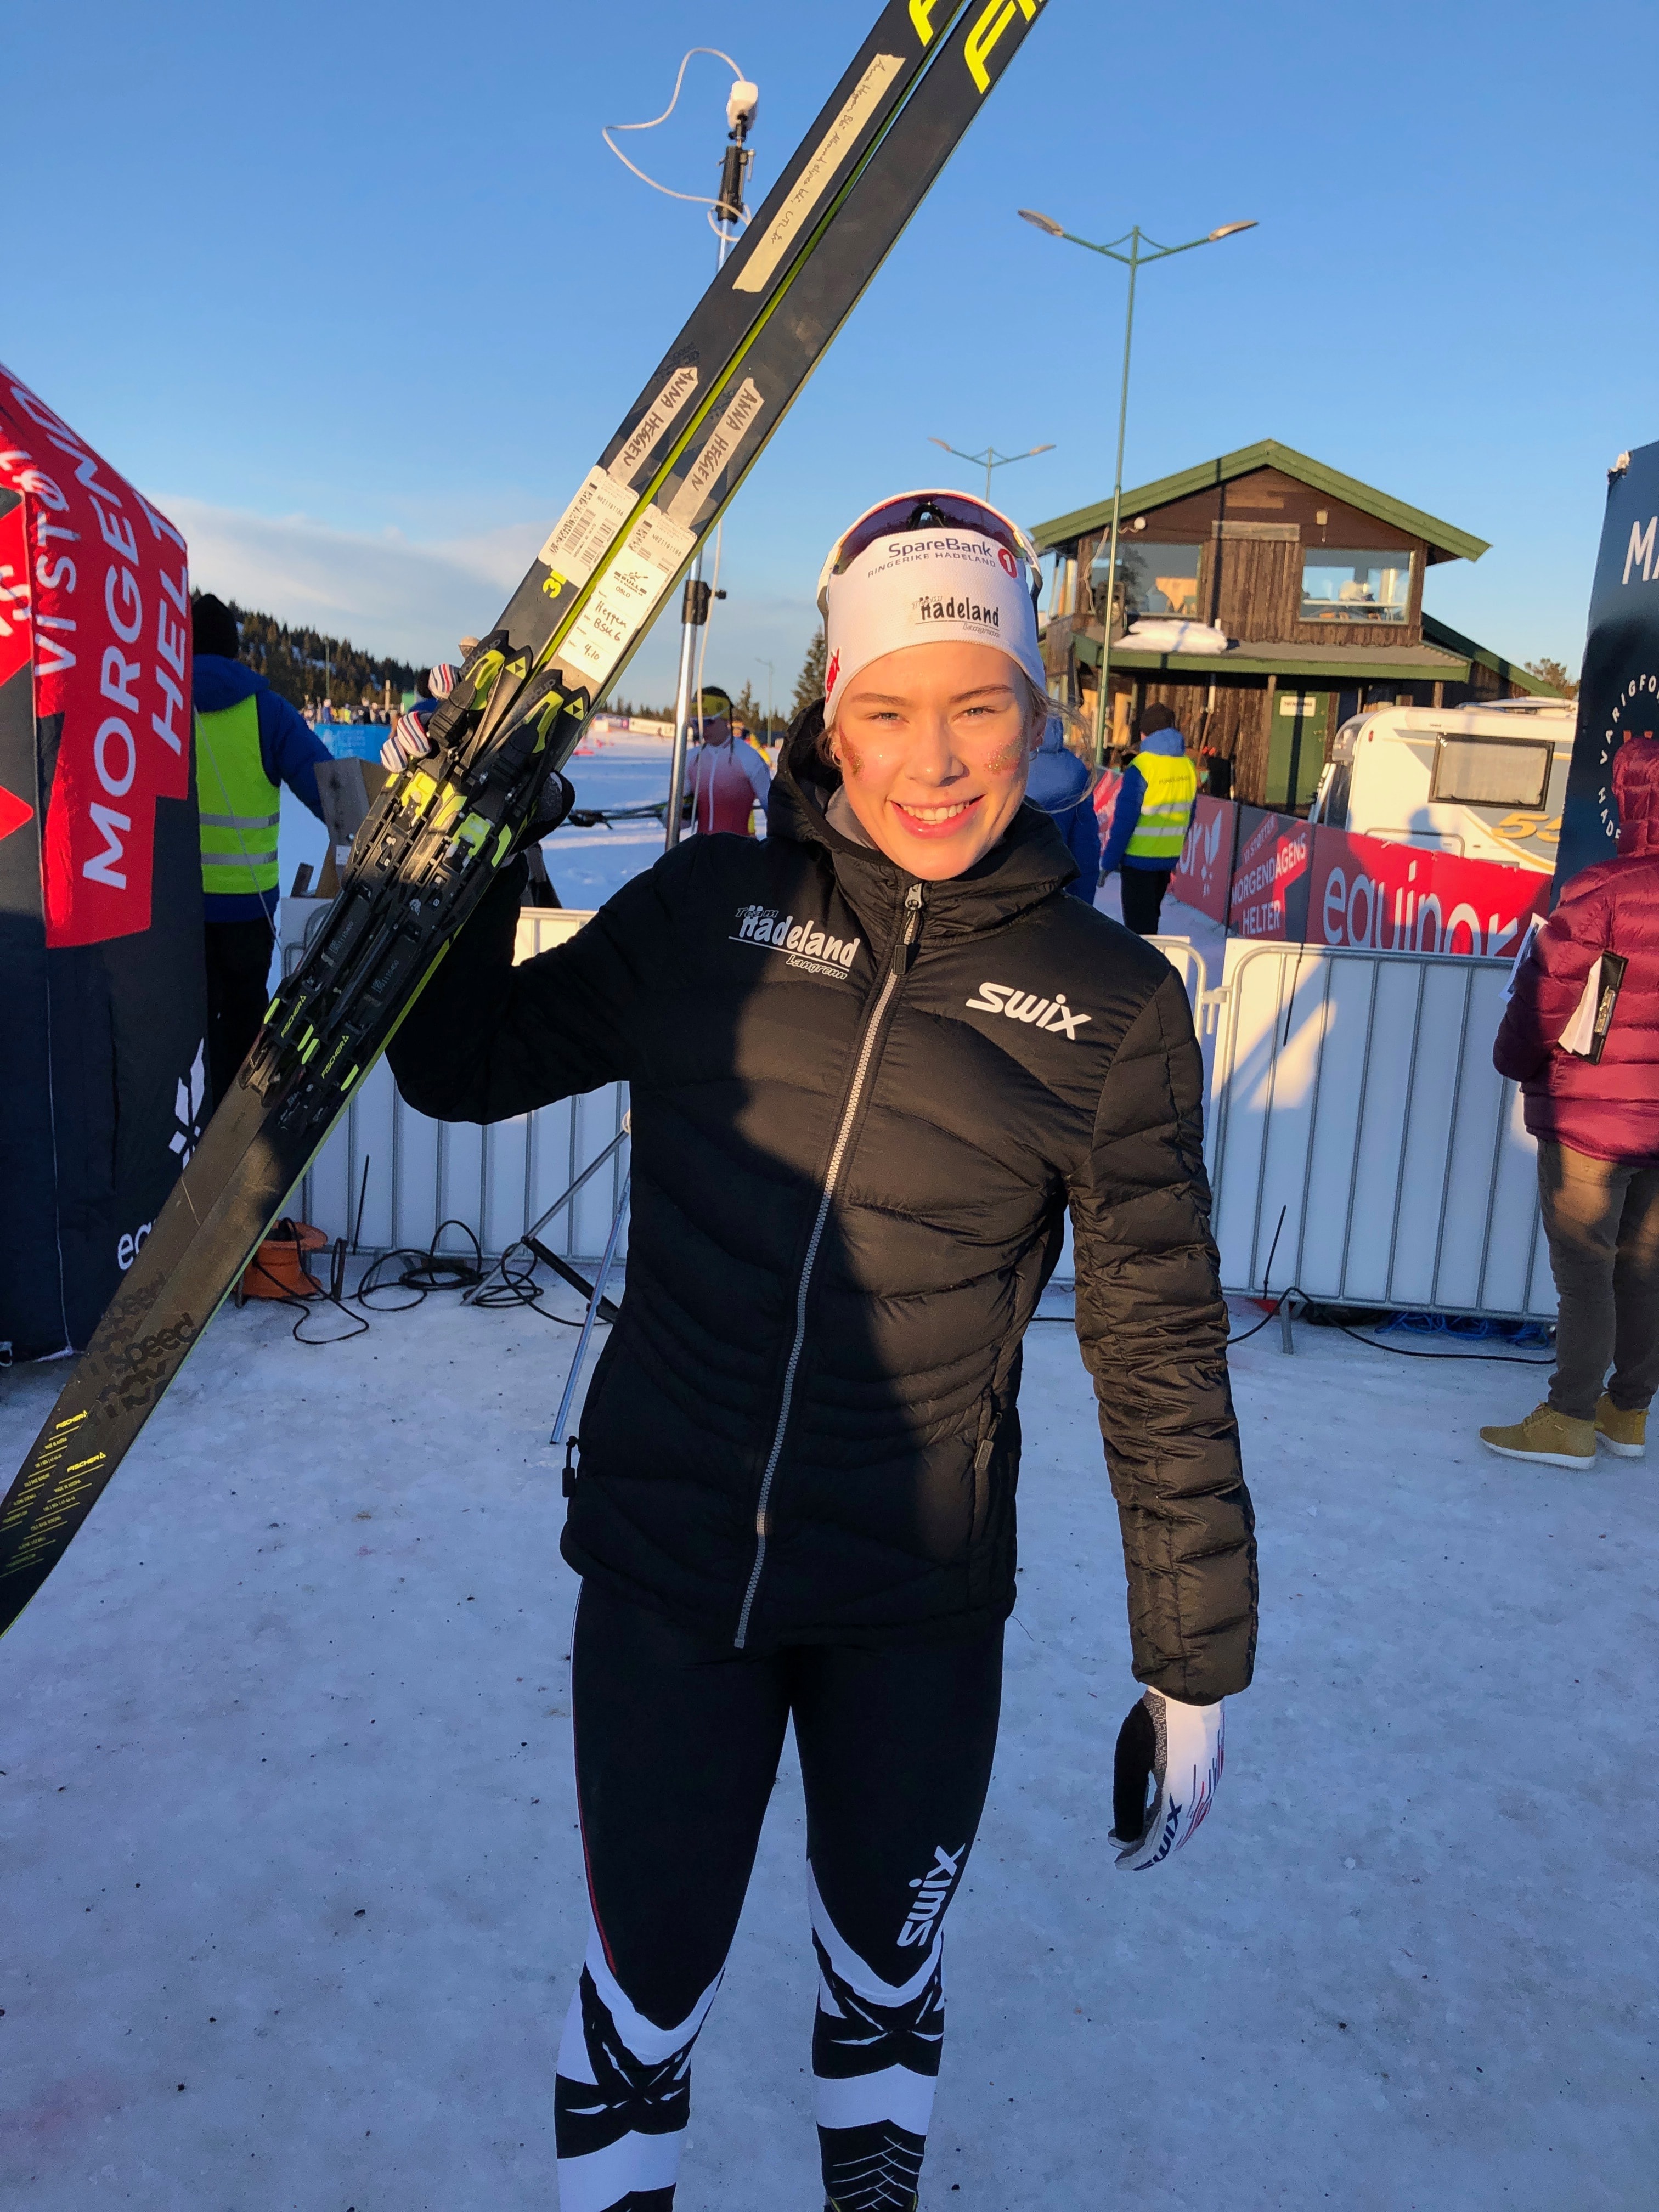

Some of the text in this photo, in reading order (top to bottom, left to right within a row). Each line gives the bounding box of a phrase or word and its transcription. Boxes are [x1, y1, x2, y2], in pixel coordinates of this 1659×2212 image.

[661, 369, 695, 409] ANNA
[725, 388, 758, 431] ANNA
[623, 411, 665, 468] HEGGEN
[692, 433, 729, 493] HEGGEN
[867, 551, 996, 578] RINGERIKE HADELAND
[888, 537, 994, 559] SpareBank
[616, 585, 631, 599] OSLO
[921, 596, 1000, 627] Hadeland
[3, 373, 142, 890] MORGEND
[34, 614, 76, 676] VI
[614, 631, 621, 642] 6
[1599, 673, 1659, 765] VARIGFO
[1249, 814, 1275, 857] STØTTER
[1232, 833, 1308, 907] MORGENDAGENS
[1242, 900, 1282, 935] HELTER
[1323, 860, 1519, 957] equinor
[738, 904, 861, 967] Hadeland
[785, 954, 848, 980] Langrenn
[280, 1002, 304, 1039] FISCHER
[321, 1040, 345, 1079] FISCHER
[115, 1311, 199, 1375] speed
[55, 1413, 84, 1431] FISCHER
[66, 1455, 100, 1473] FISCHER
